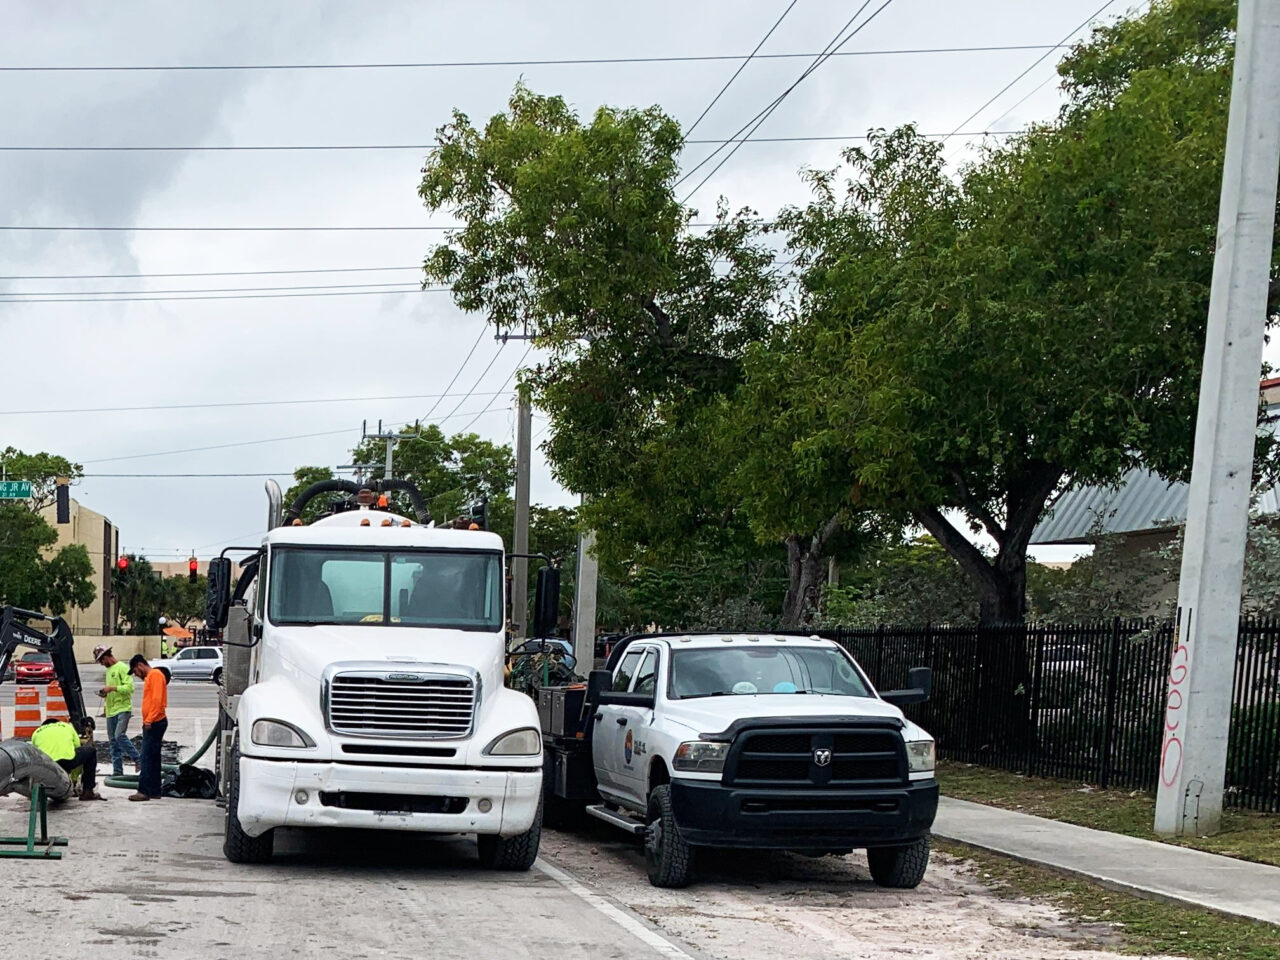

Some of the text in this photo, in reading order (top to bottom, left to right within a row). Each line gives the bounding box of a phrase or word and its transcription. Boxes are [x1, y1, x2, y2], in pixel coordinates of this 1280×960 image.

[10, 482, 18, 491] JR
[21, 482, 30, 491] AV
[24, 634, 41, 646] DEERE
